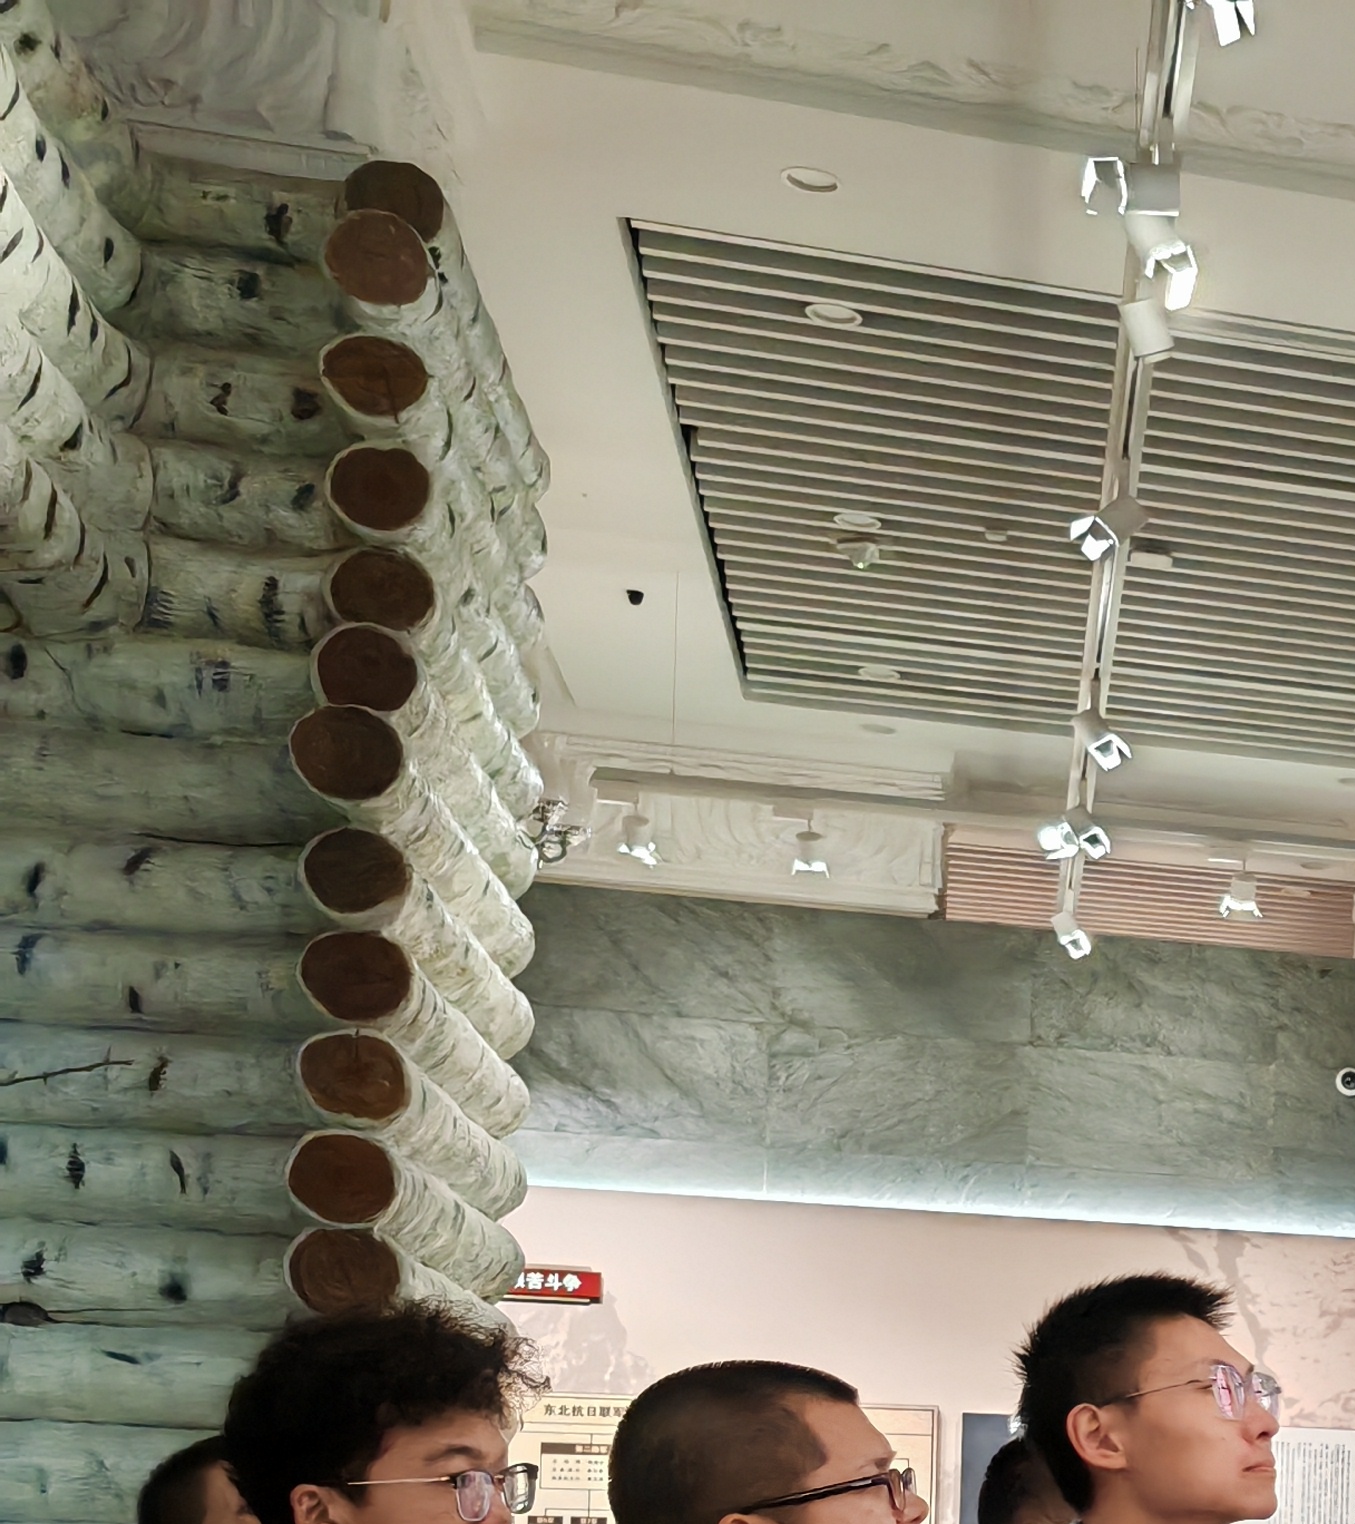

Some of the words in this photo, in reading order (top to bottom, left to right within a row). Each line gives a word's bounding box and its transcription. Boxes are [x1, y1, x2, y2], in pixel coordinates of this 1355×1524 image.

[544, 1403, 630, 1419] 东北抗日联军
